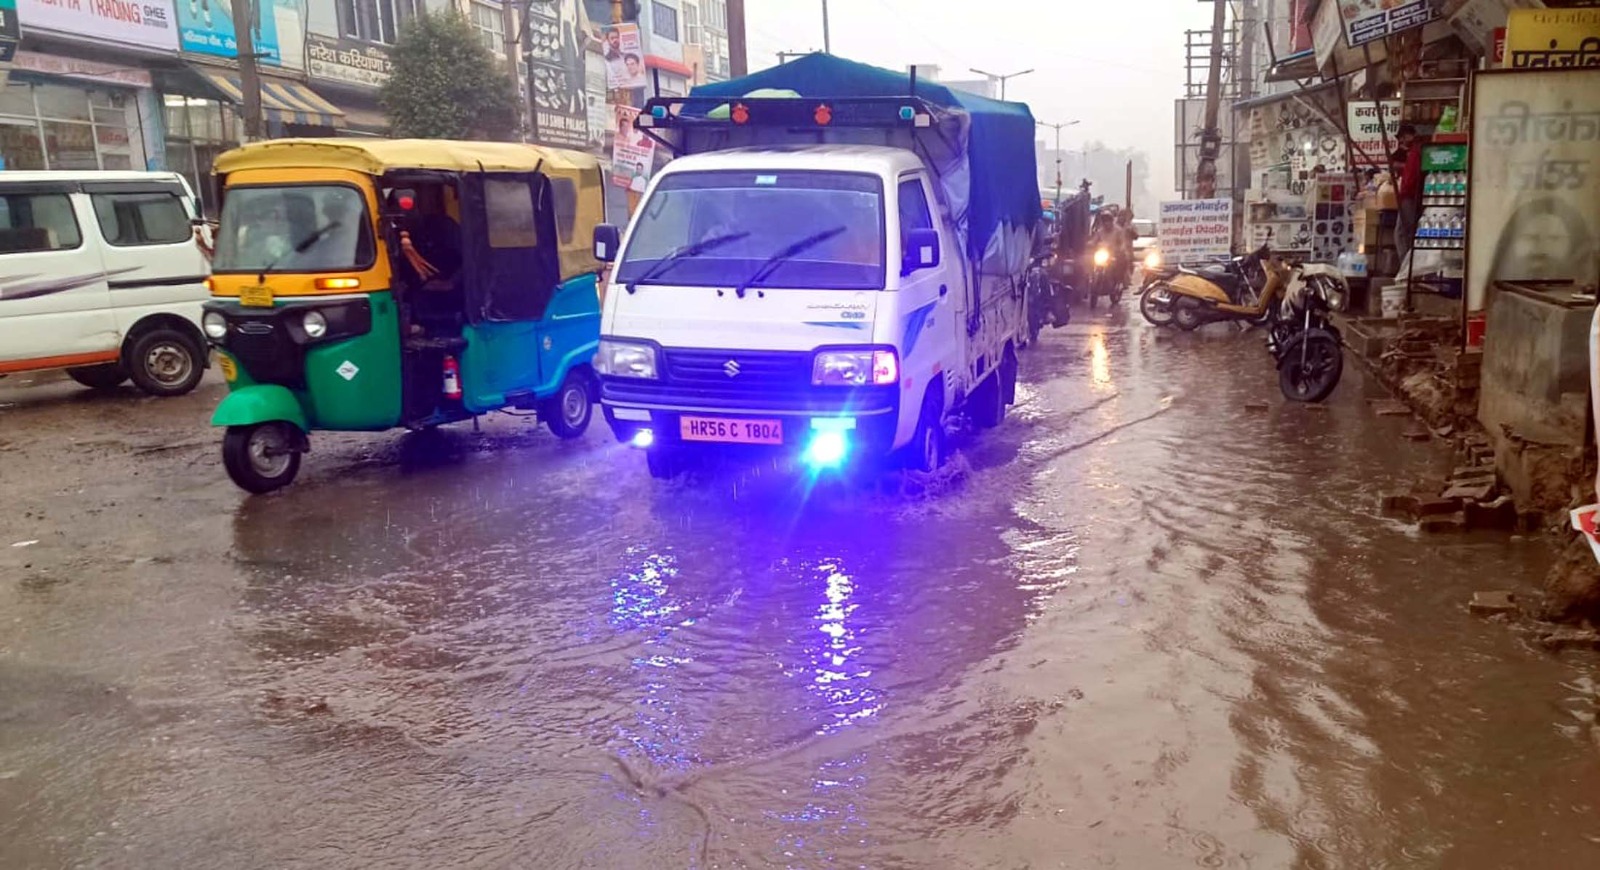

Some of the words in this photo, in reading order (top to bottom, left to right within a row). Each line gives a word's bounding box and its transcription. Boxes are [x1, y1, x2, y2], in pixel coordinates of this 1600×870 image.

[89, 0, 141, 24] TRADING
[143, 5, 166, 20] GHEE
[690, 420, 726, 437] HR56
[730, 422, 738, 437] C
[745, 423, 780, 439] 1804
